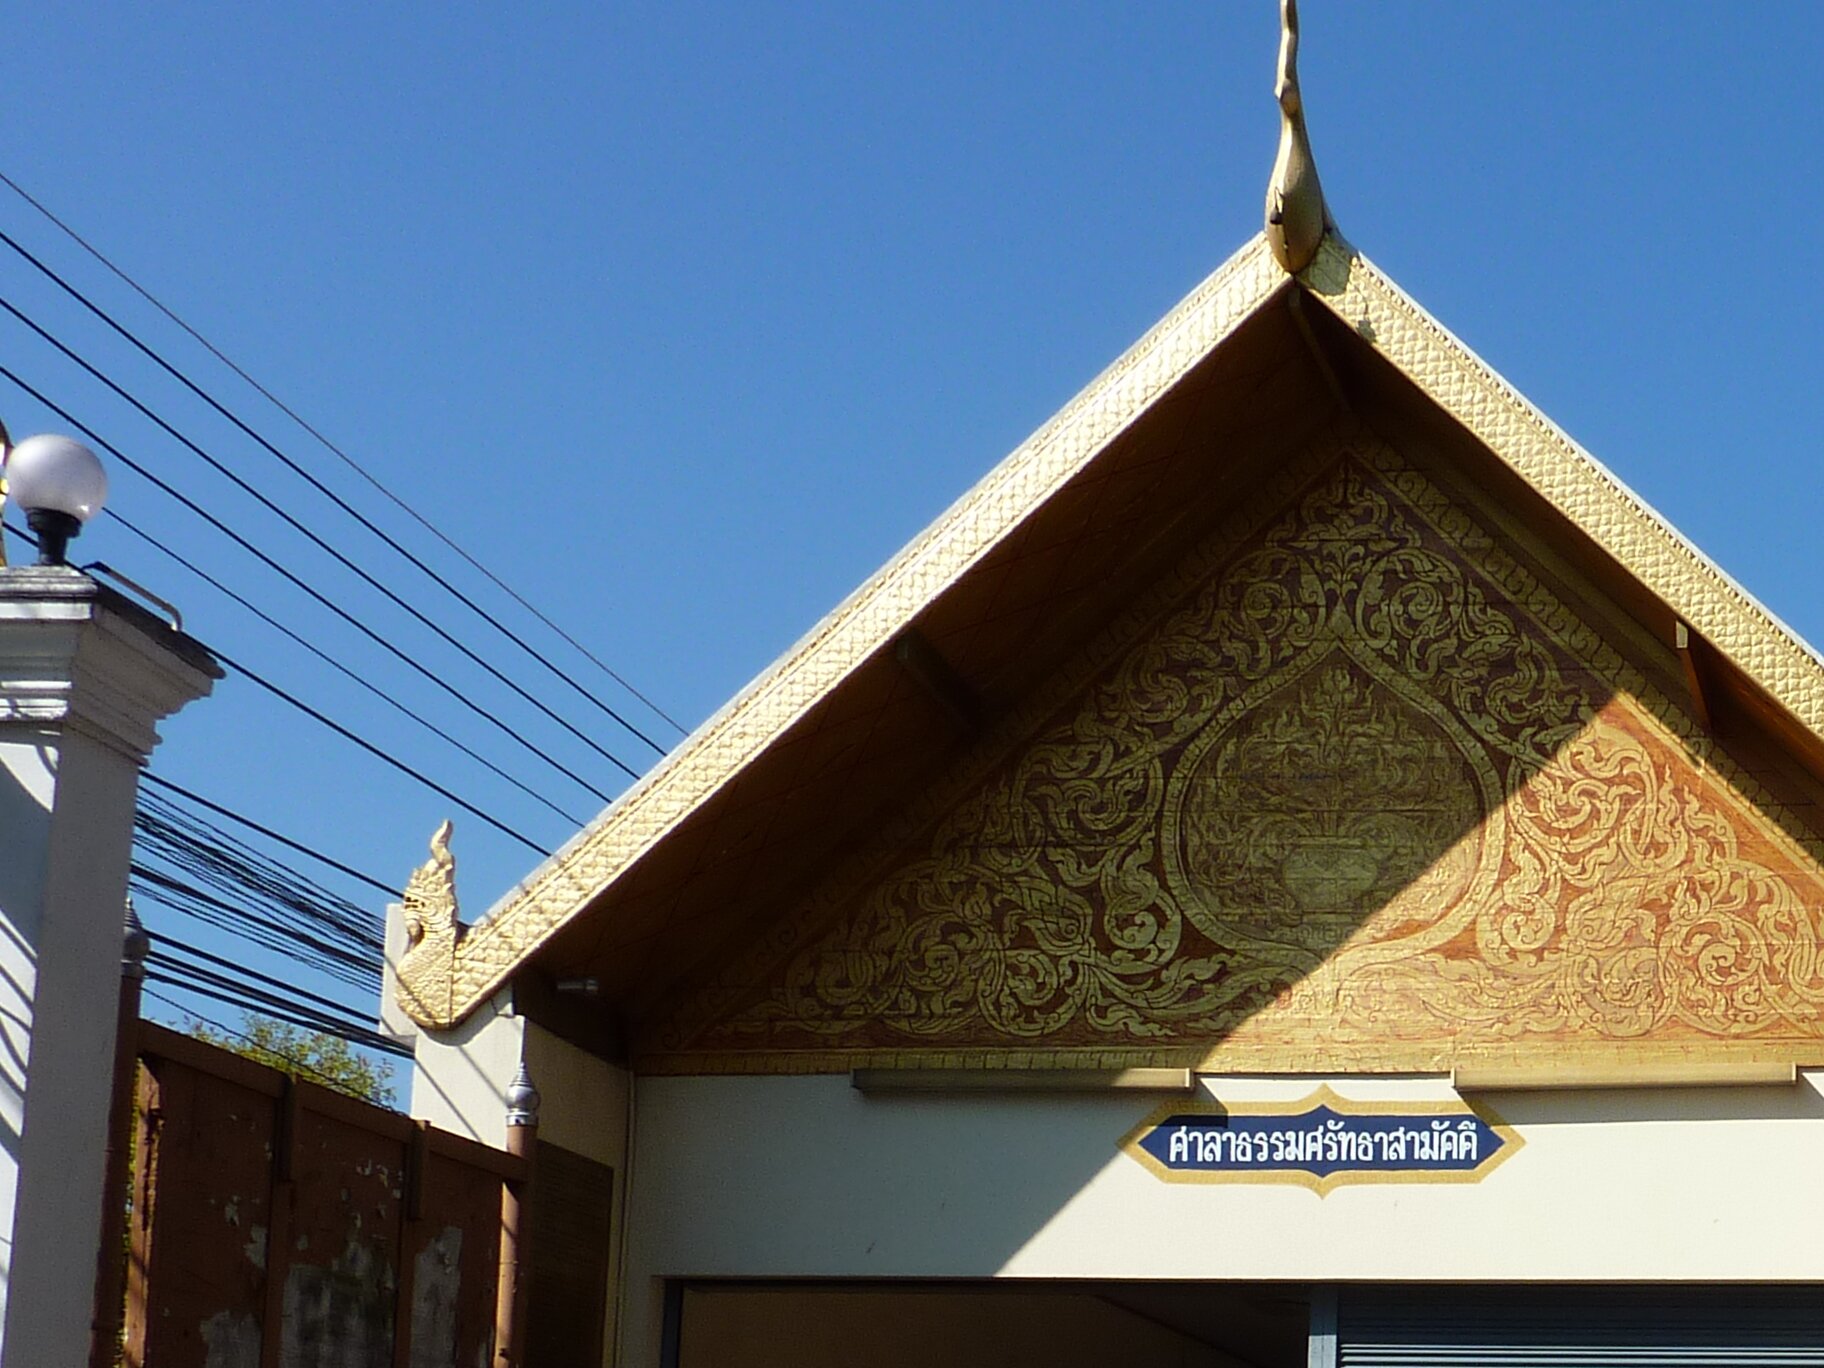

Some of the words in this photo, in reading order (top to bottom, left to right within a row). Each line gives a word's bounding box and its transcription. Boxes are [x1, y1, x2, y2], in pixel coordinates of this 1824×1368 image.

[1168, 1119, 1478, 1163] ศาลาธรรมศรัทธาสามัคคี
